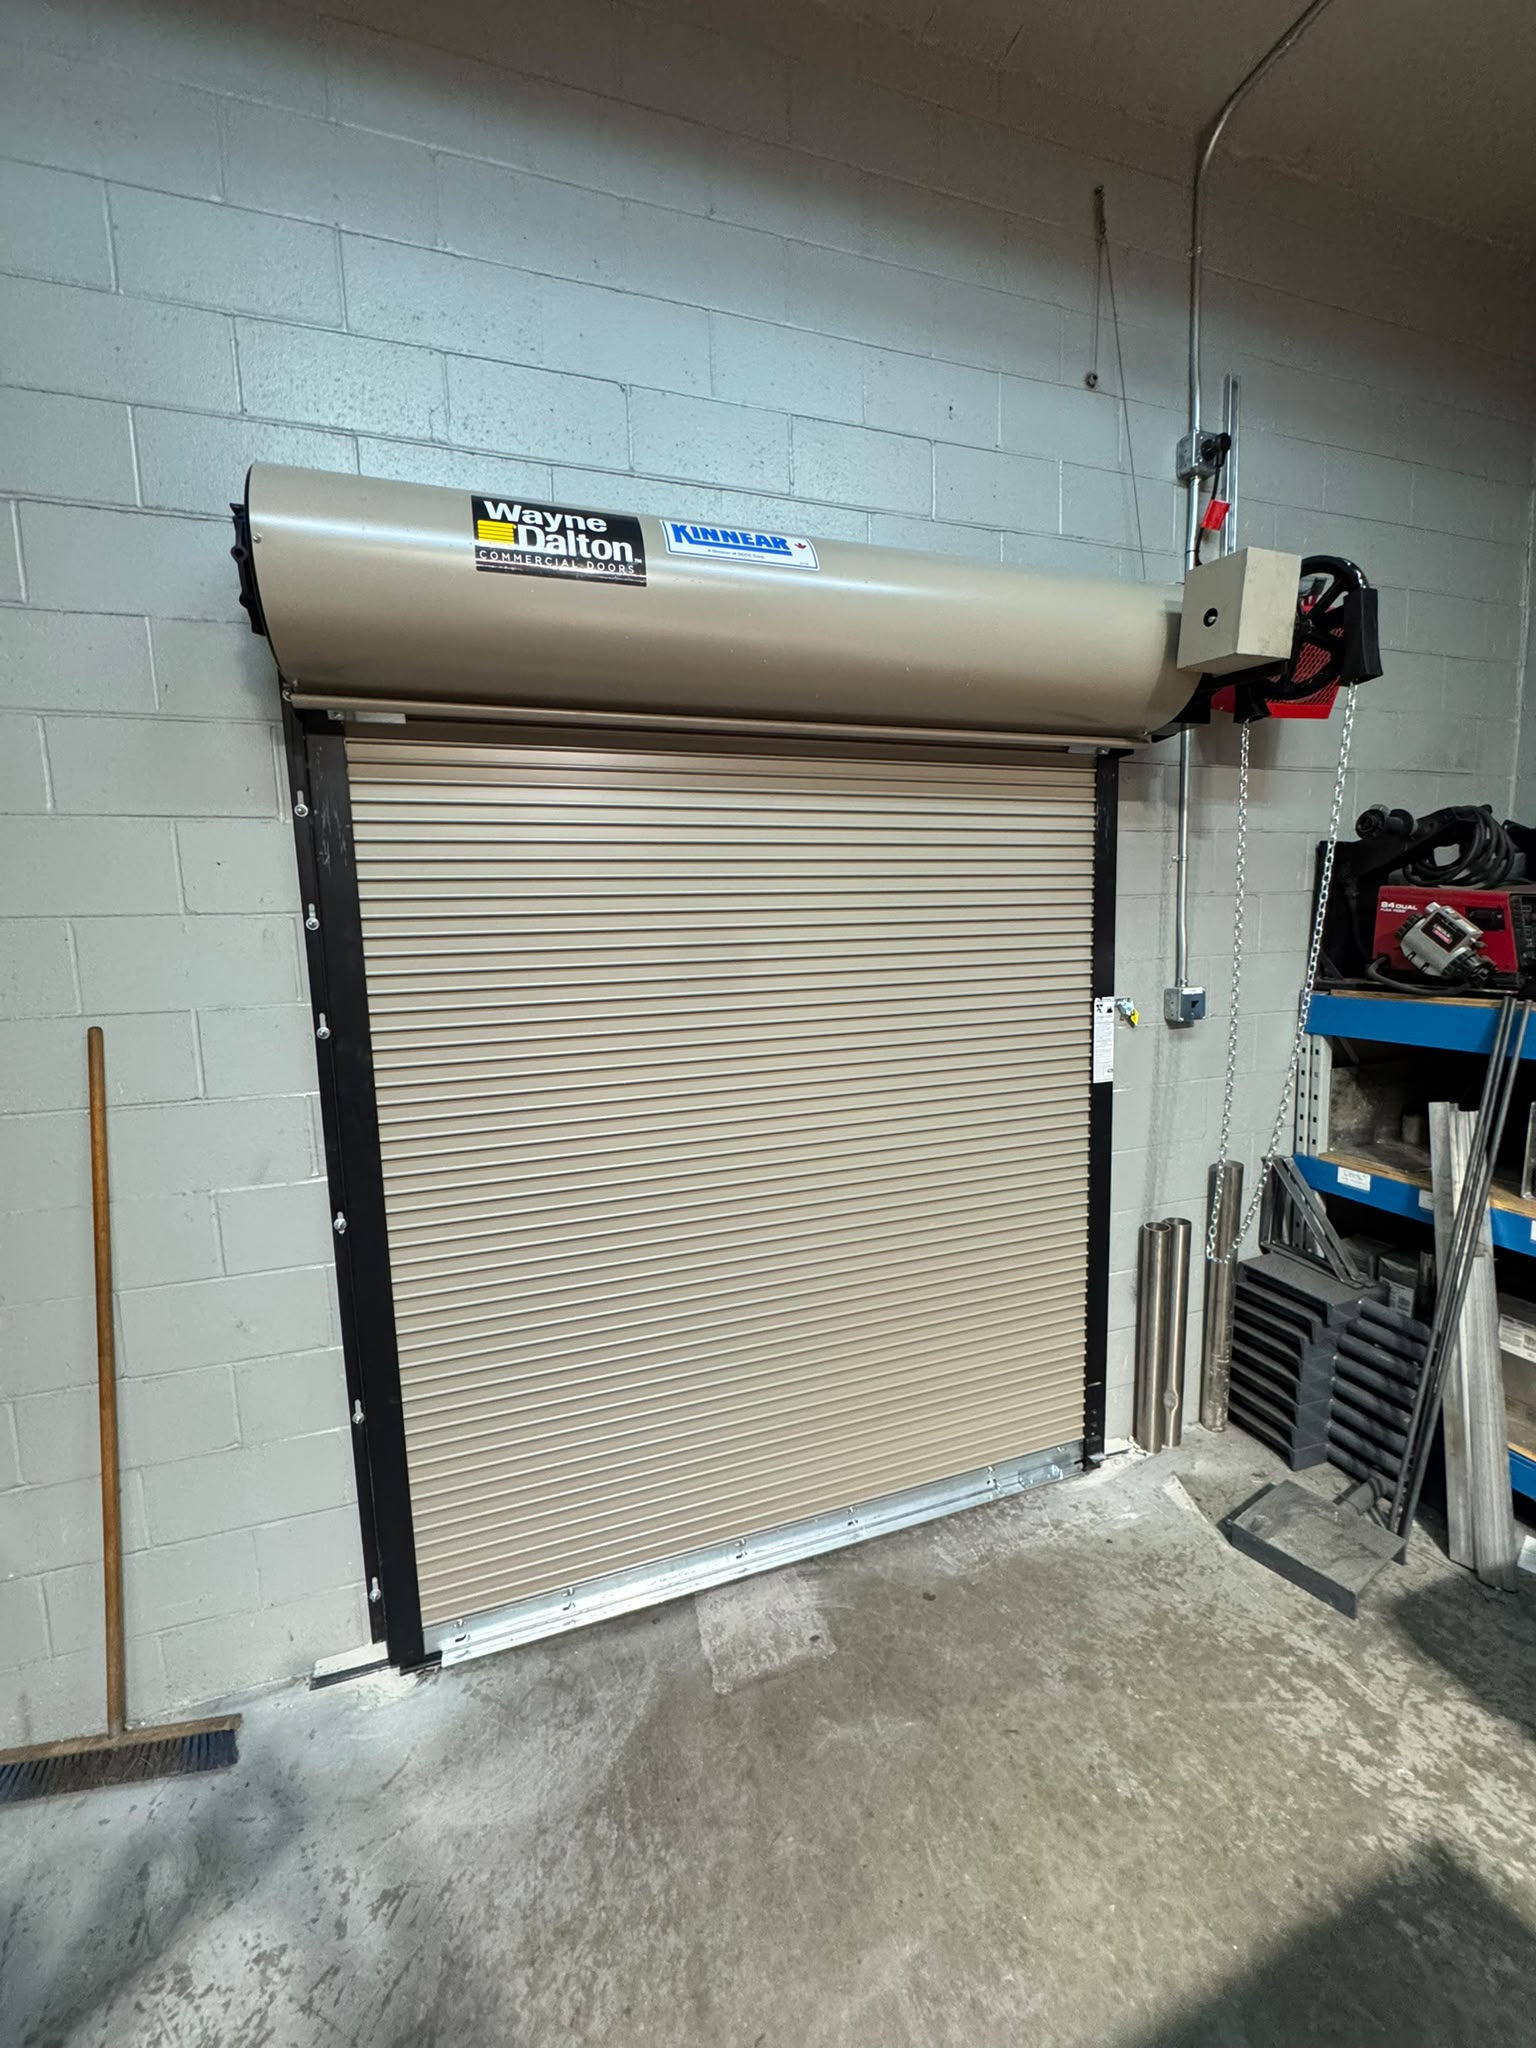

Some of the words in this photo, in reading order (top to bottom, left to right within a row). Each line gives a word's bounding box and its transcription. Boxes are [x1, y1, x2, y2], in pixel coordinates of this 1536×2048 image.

[483, 500, 608, 533] Wayne
[517, 524, 634, 563] Dalton
[670, 523, 792, 551] KINNEAR
[479, 550, 577, 569] COMMERCIAL
[586, 560, 635, 574] DOORS
[1395, 903, 1418, 911] DUAL
